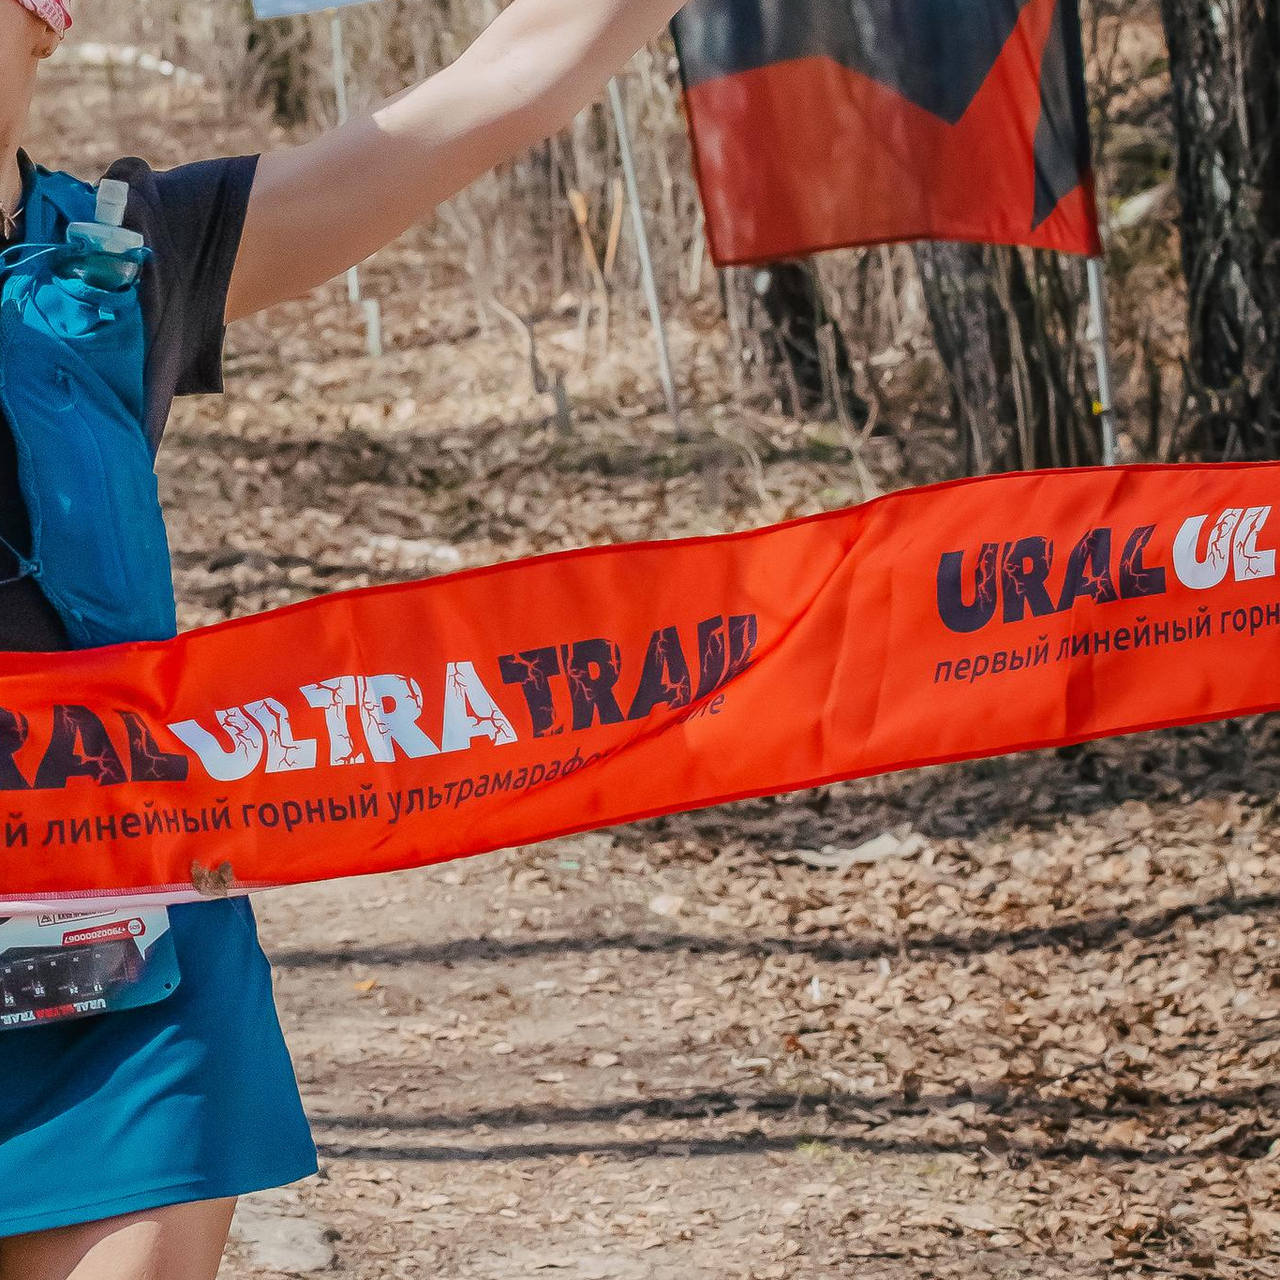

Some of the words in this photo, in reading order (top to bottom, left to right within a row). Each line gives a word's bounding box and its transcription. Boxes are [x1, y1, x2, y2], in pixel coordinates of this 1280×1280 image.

[934, 635, 1050, 684] первый
[1056, 606, 1212, 663] линейный
[42, 798, 231, 847] линейный
[243, 782, 378, 834] горный
